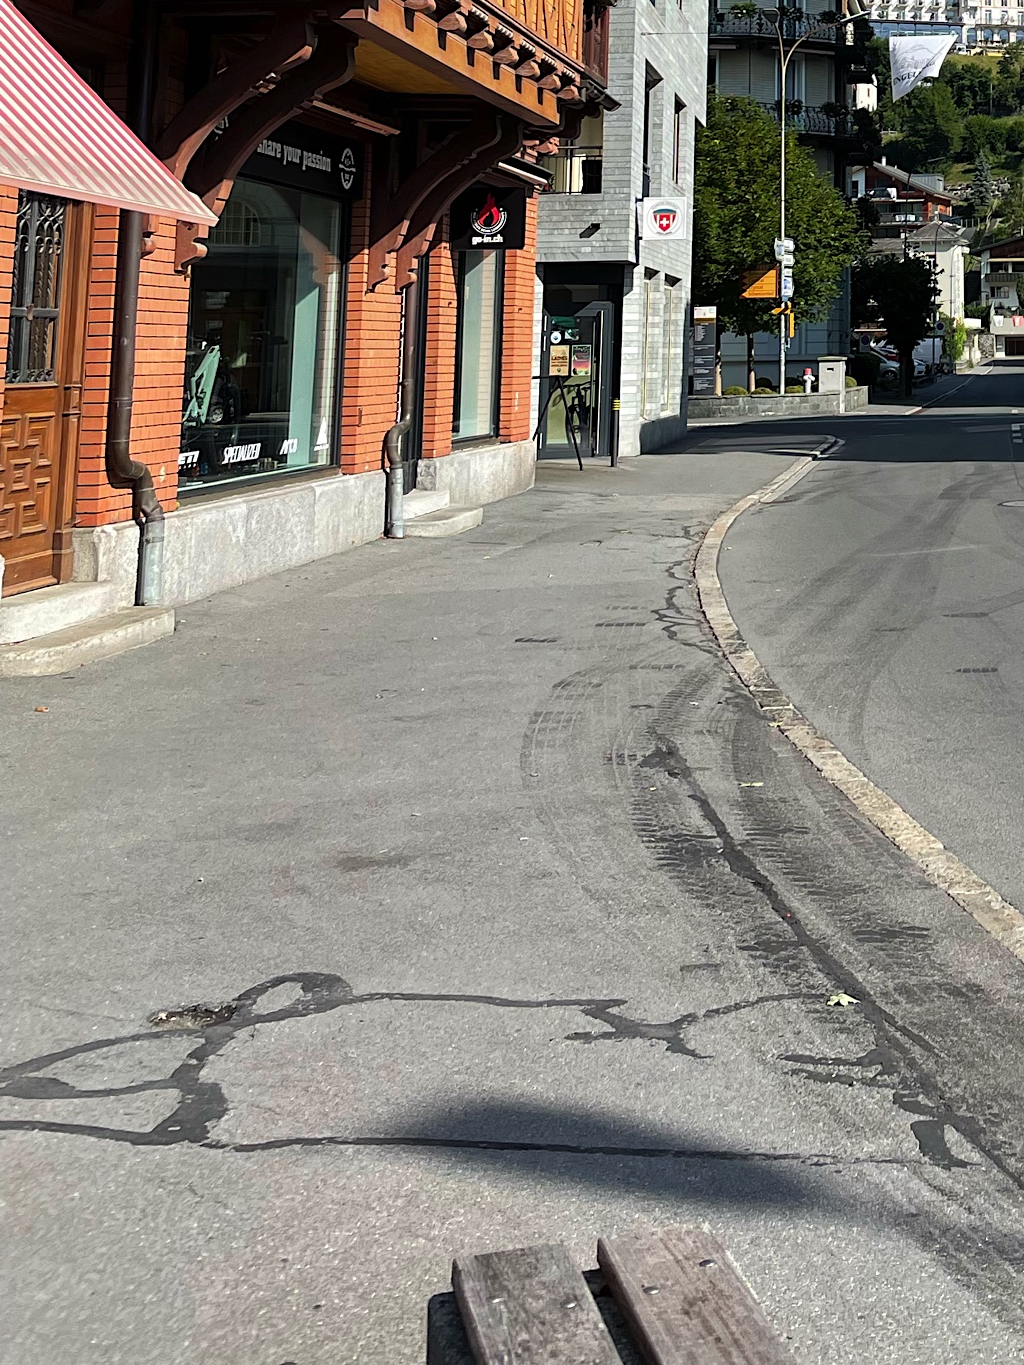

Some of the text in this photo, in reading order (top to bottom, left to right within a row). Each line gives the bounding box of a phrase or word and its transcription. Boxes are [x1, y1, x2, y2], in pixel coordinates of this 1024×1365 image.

[283, 145, 301, 165] your
[302, 150, 331, 172] passion
[472, 234, 503, 245] go-in.ch
[178, 450, 200, 464] ETI
